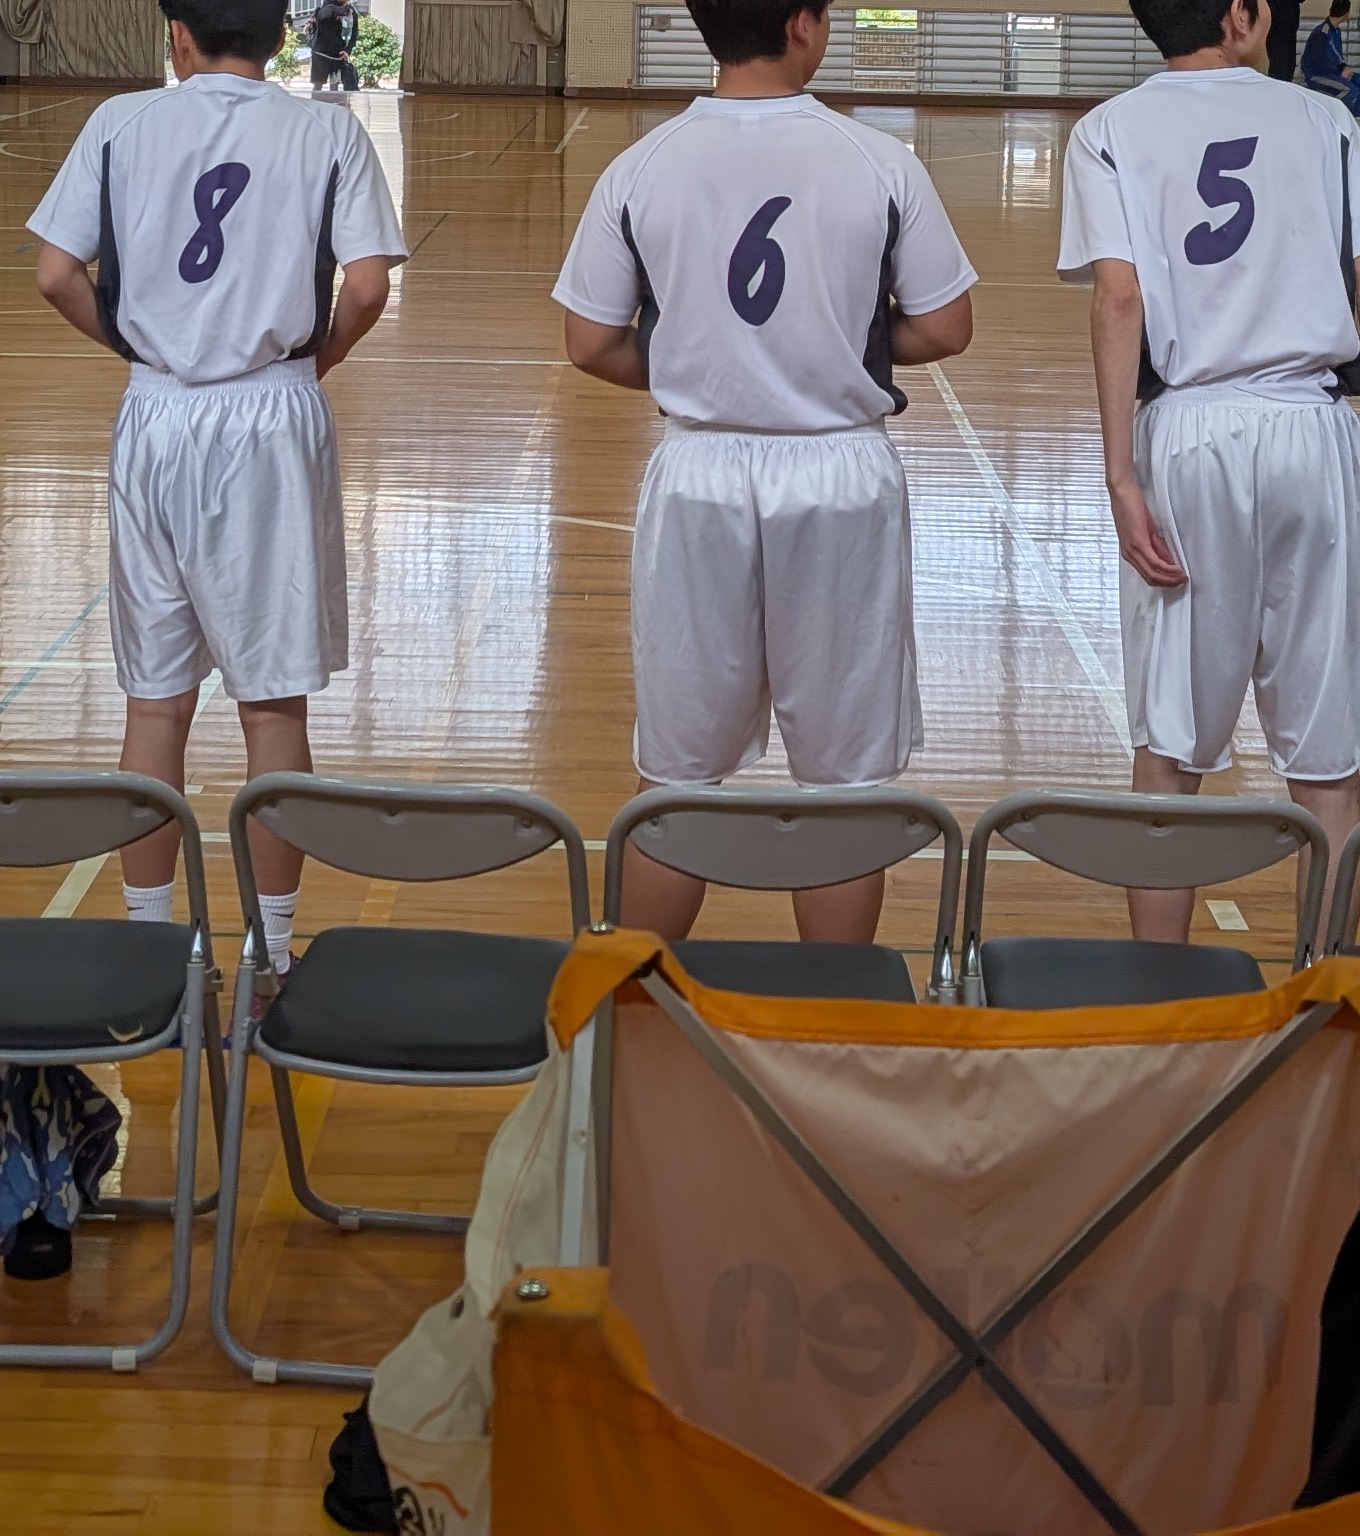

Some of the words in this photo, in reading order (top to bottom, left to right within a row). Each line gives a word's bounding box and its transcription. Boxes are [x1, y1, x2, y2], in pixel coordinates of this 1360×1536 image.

[177, 161, 252, 284] 8
[727, 195, 793, 327] 6
[1183, 135, 1259, 266] 5
